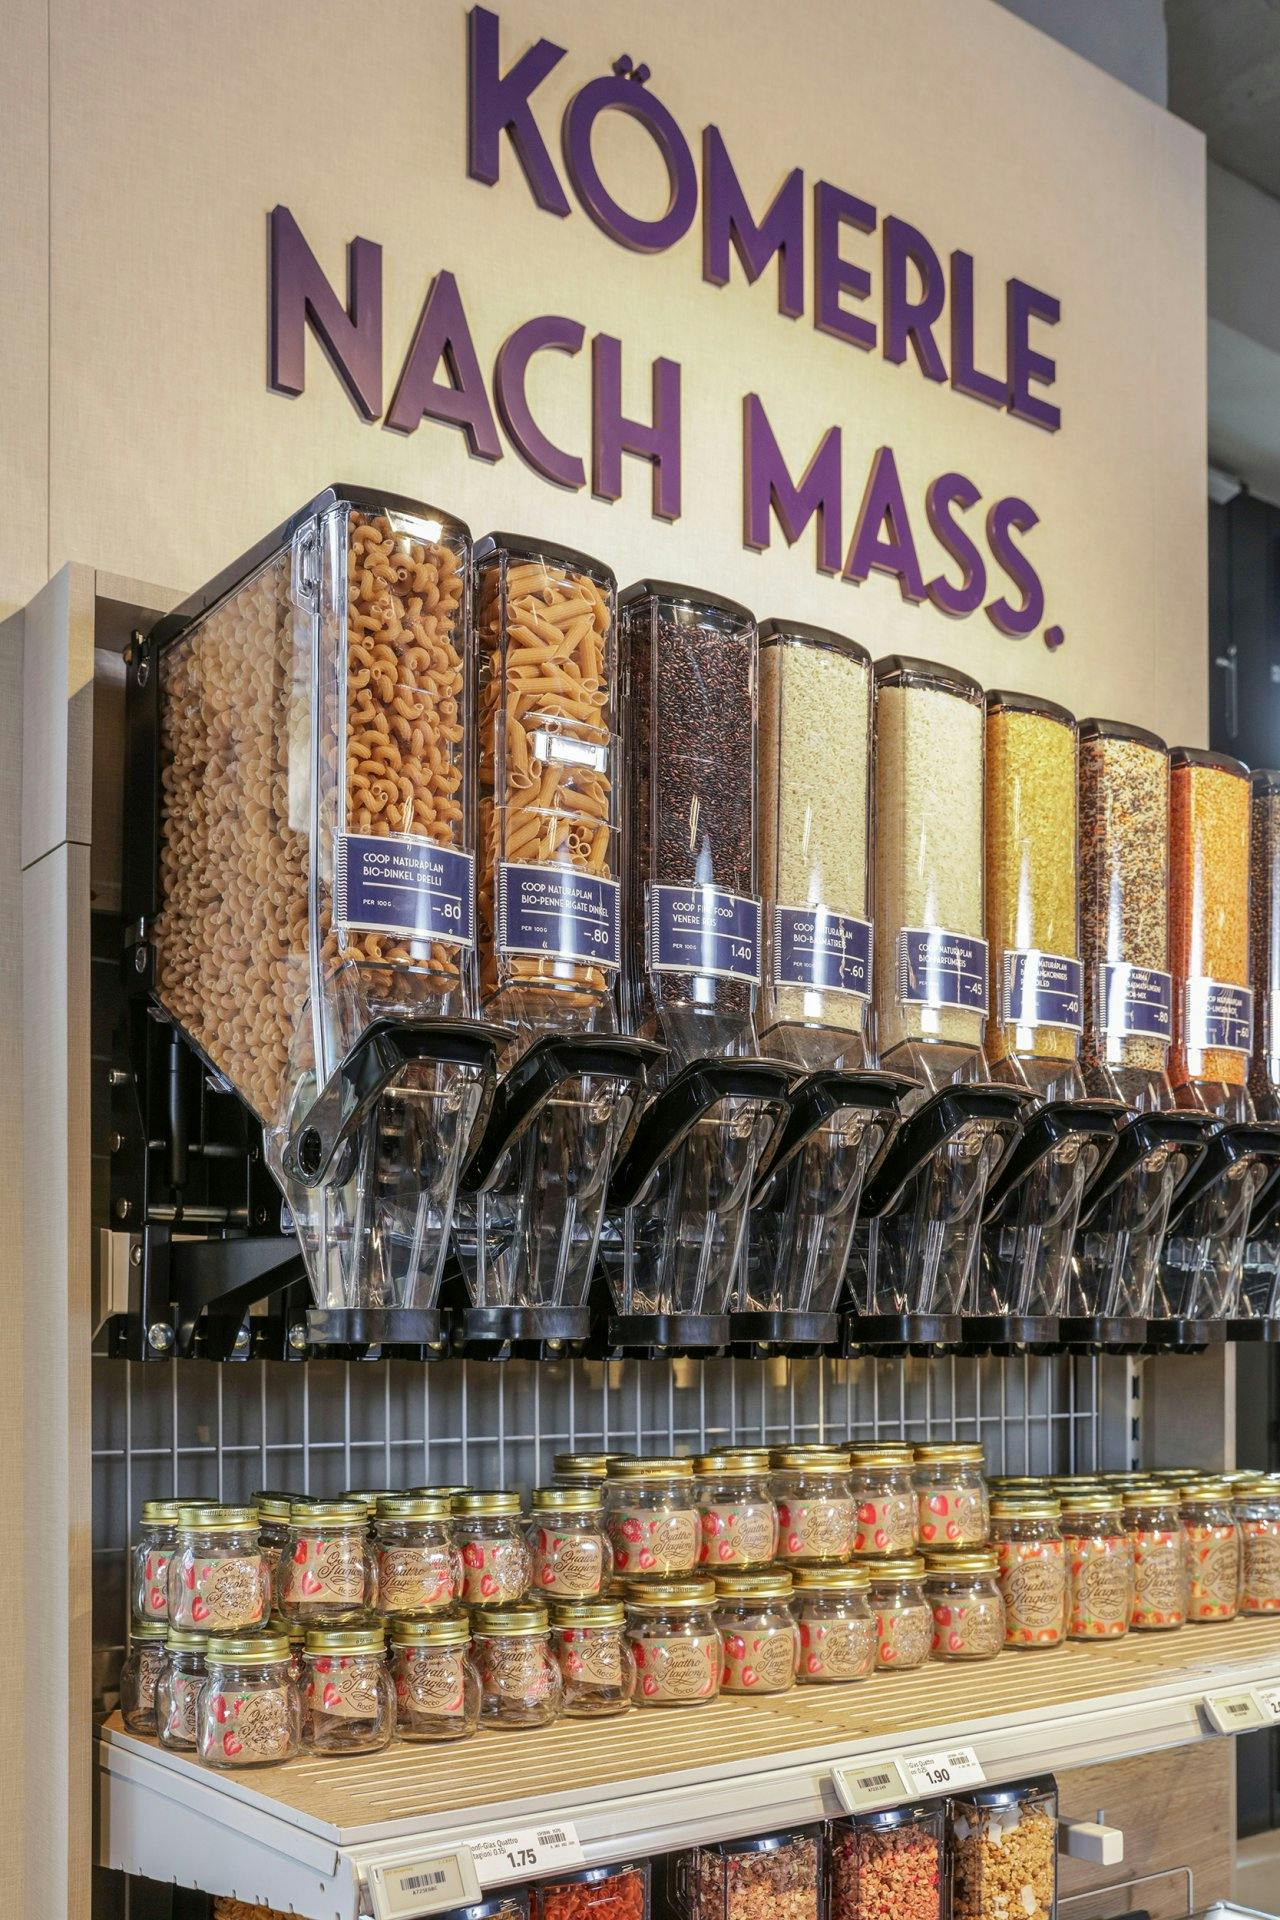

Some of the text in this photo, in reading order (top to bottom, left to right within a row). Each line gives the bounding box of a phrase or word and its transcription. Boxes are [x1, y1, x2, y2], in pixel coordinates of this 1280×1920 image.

[466, 5, 1061, 431] KÖMERLE
[267, 204, 1065, 650] NACH MASS.
[363, 853, 444, 873] COOP NATURAPLAN
[363, 866, 442, 886] BIO-DINKEL DRELLI
[521, 882, 593, 900] COOP NATURAPLAN
[521, 894, 609, 918] BIO-PENNE RIGATE DINKEL
[672, 901, 695, 912] COOP
[714, 907, 734, 918] FOOD
[672, 914, 700, 925] VENERE
[793, 922, 815, 932] COOP
[731, 944, 752, 960] 1.40
[925, 1768, 950, 1784] 1.90
[496, 1837, 519, 1848] Quattro
[507, 1848, 538, 1868] 1.75
